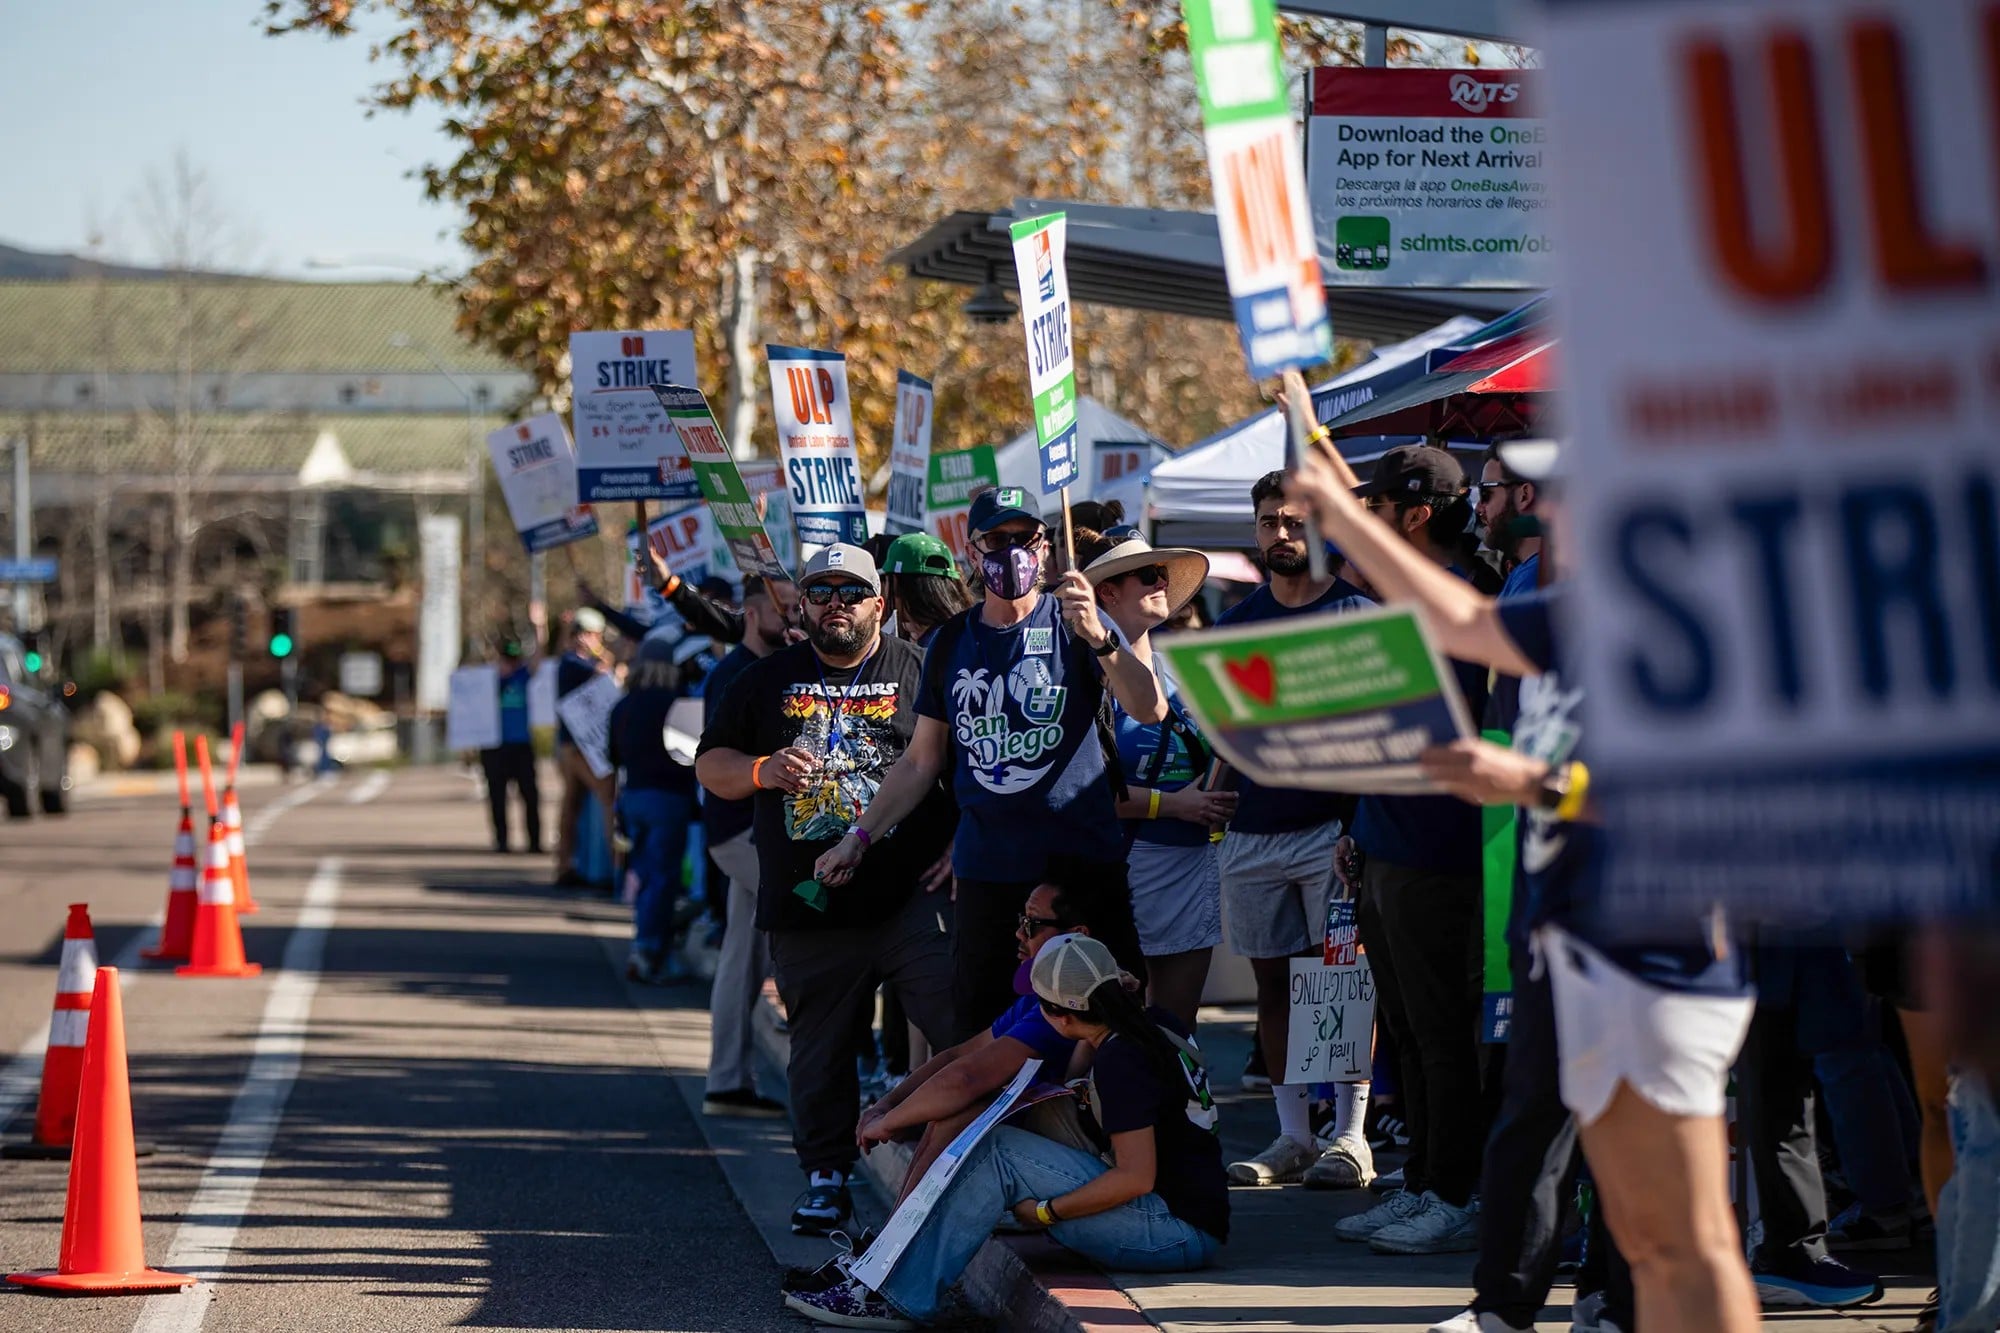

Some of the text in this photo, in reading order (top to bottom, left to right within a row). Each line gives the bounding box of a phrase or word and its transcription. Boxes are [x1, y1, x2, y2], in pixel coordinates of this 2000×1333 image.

[1450, 82, 1521, 103] MTS
[1337, 124, 1445, 144] Download
[1450, 126, 1484, 144] the
[1336, 149, 1380, 170] App
[1386, 149, 1415, 167] for
[1421, 150, 1471, 168] Next
[1335, 177, 1401, 194] Descarga
[1403, 178, 1416, 192] la
[1419, 180, 1446, 195] app
[1334, 195, 1356, 208] los
[1358, 195, 1422, 211] próximos
[1425, 195, 1482, 208] horarios
[1485, 196, 1504, 209] de
[1032, 301, 1069, 376] STRIKE
[597, 360, 672, 388] STRIKE
[786, 367, 835, 425] ULP
[788, 456, 861, 506] STRIKE
[782, 682, 899, 697] STAR WARS
[956, 711, 1010, 746] San
[970, 724, 1064, 768] Diego
[1328, 925, 1358, 948] STRIKE
[1338, 942, 1356, 963] ULP
[1292, 969, 1374, 1005] GASLIGHTING
[1300, 1042, 1361, 1074] Tired of
